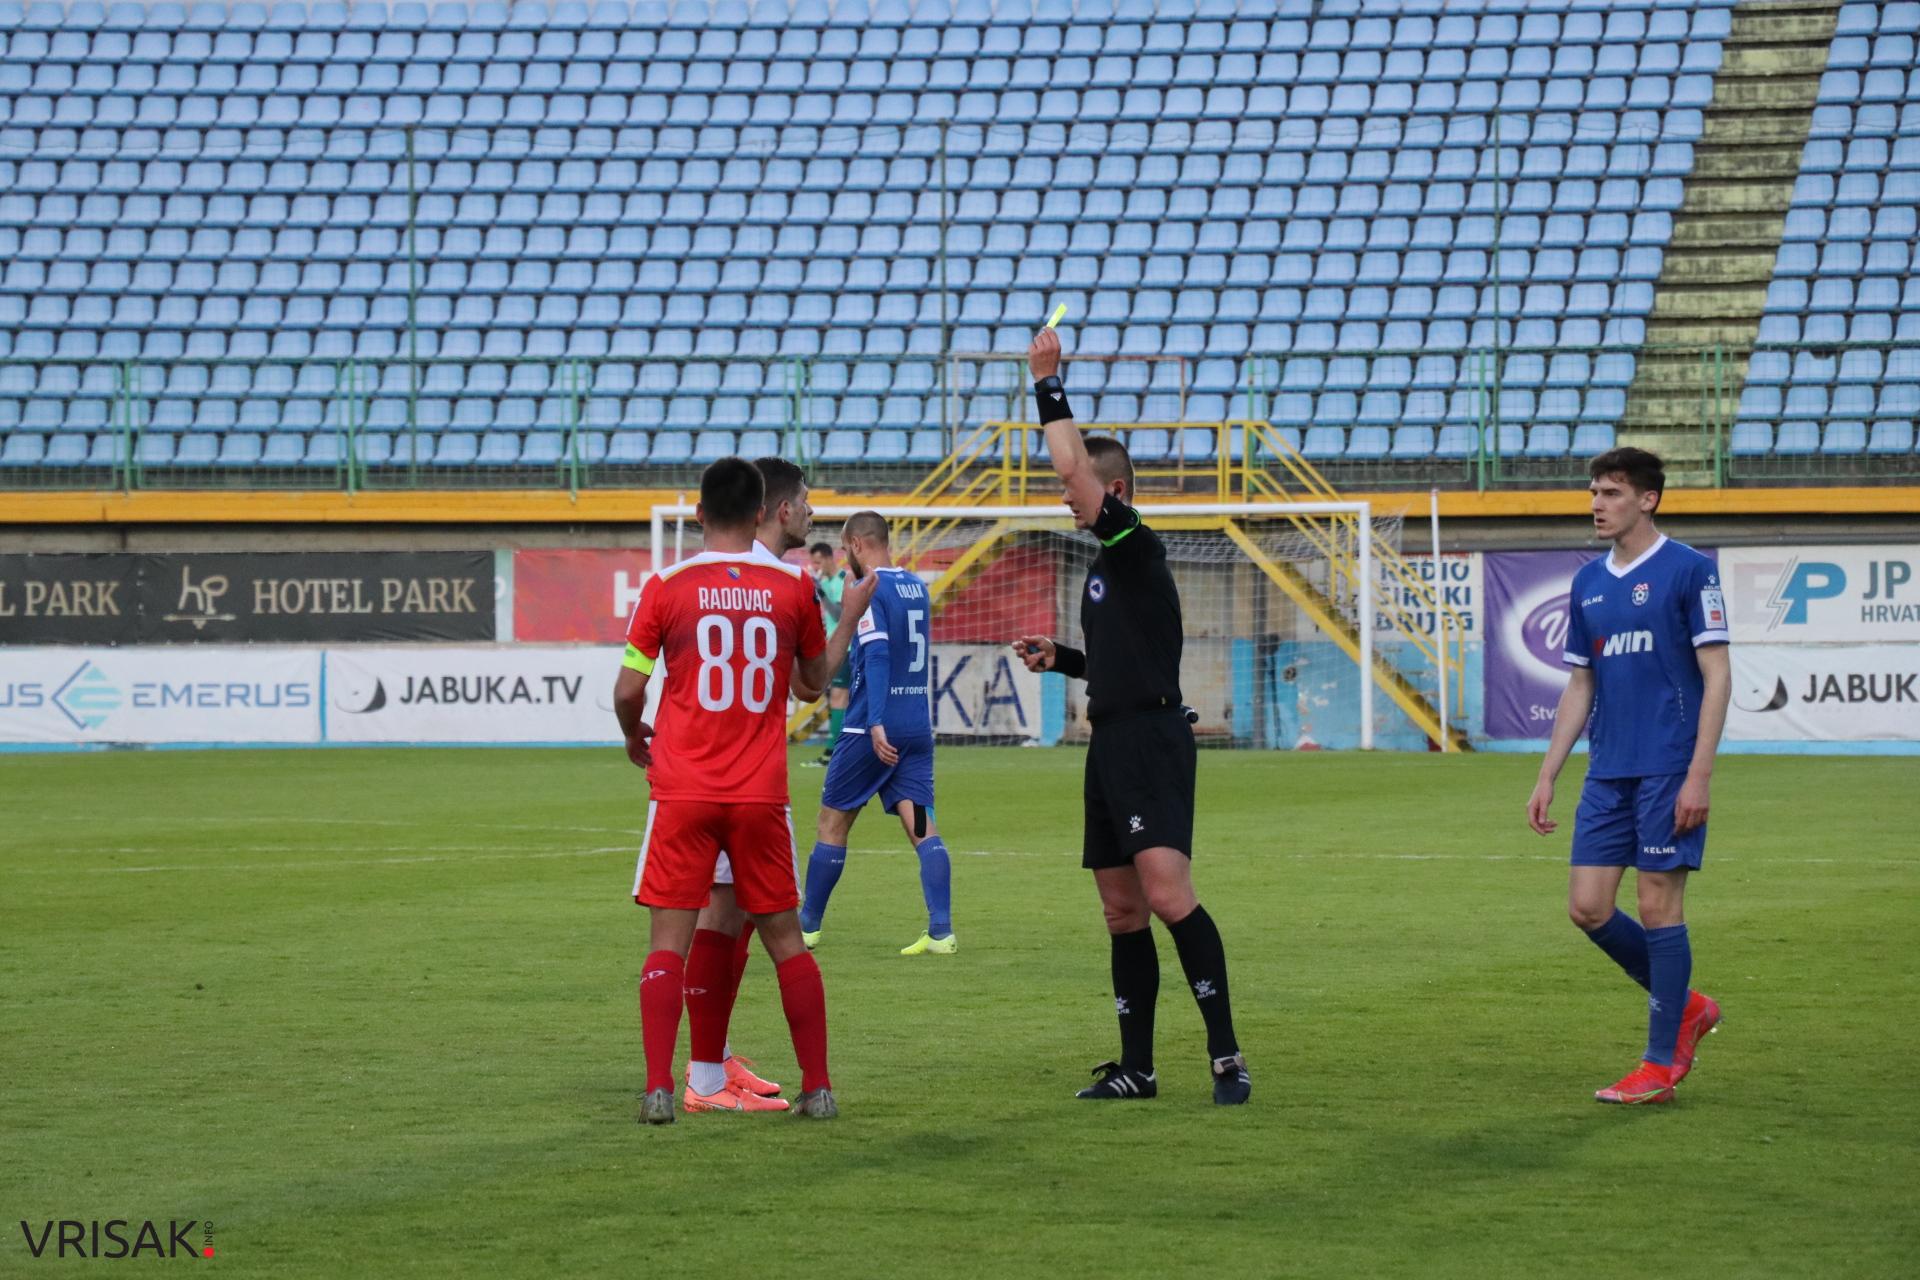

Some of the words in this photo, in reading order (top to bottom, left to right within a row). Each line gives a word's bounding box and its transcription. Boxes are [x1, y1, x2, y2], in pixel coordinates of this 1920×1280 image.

[1863, 561, 1911, 599] JP
[24, 581, 119, 616] PARK
[253, 579, 372, 614] HOTEL
[381, 578, 477, 614] PARK
[698, 587, 773, 612] RADOVAC
[907, 610, 925, 672] 5
[696, 614, 777, 713] 88
[132, 683, 311, 708] EMERUS
[400, 676, 583, 704] JABUKA.TV
[1802, 673, 1920, 703] JABUK
[1530, 705, 1557, 720] Stv
[1643, 846, 1677, 854] KELME
